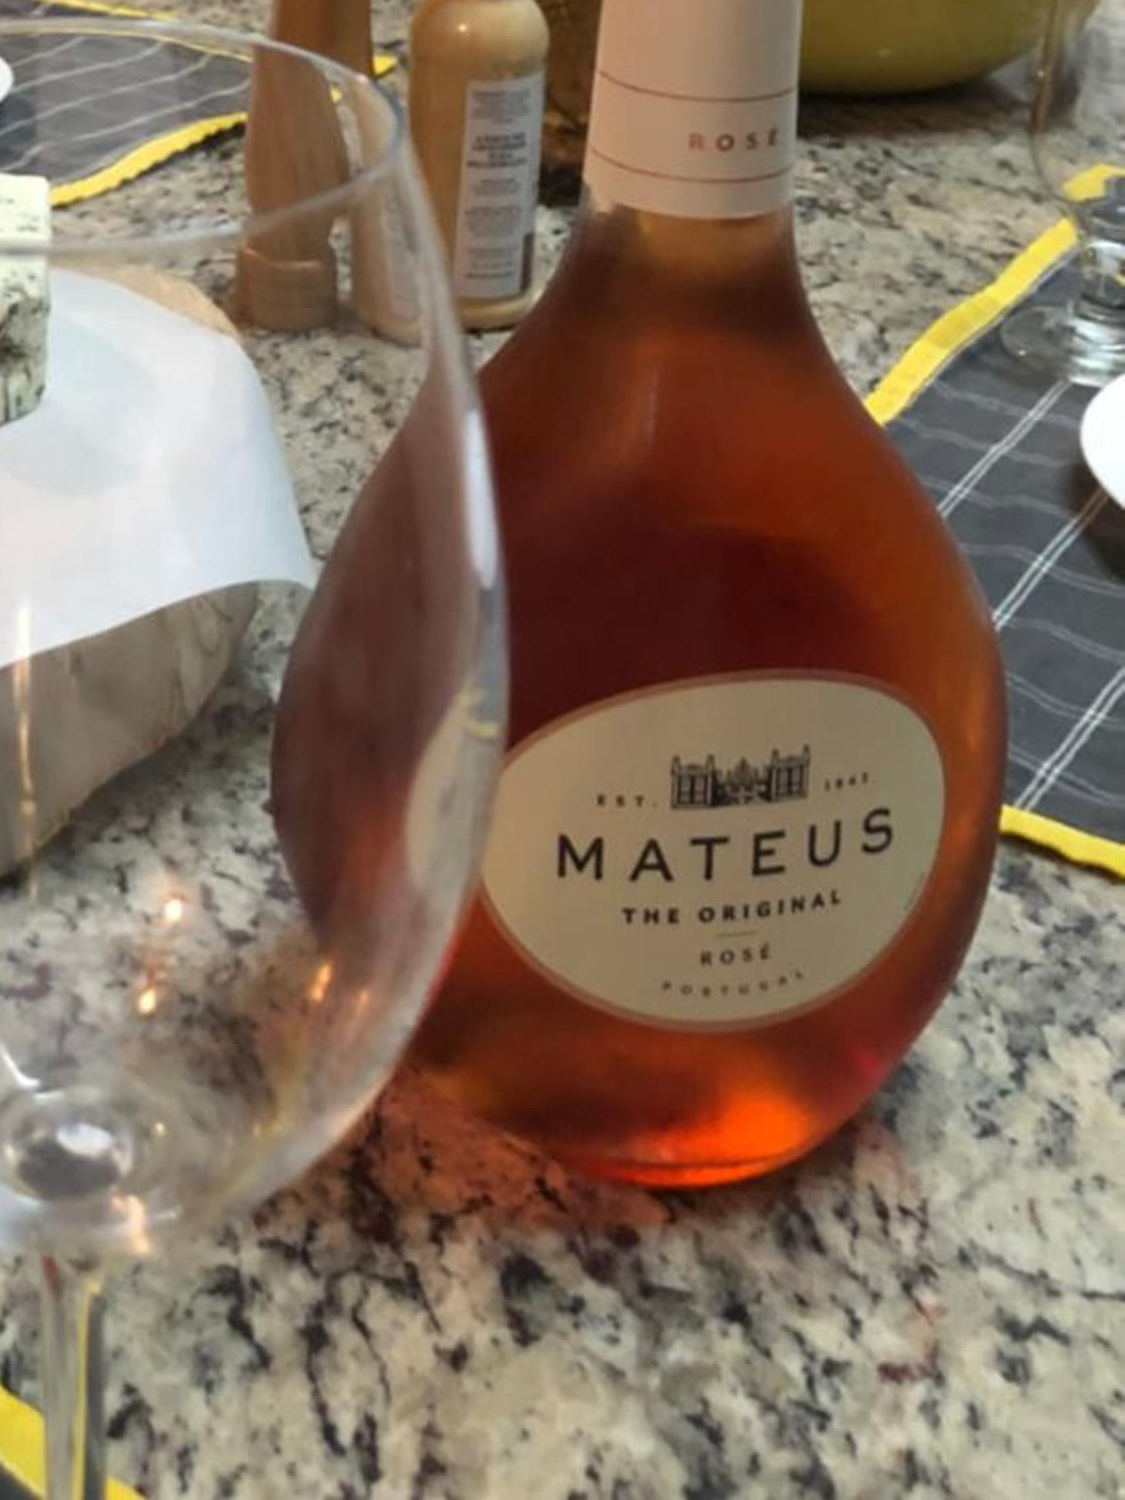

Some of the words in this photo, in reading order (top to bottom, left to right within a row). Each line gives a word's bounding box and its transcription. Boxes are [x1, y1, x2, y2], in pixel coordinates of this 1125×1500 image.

[556, 807, 894, 883] MATEUS
[621, 906, 681, 925] THE
[698, 890, 843, 923] ORIGINAL
[699, 943, 772, 967] ROSÉ
[660, 968, 806, 998] PORTUGAL
